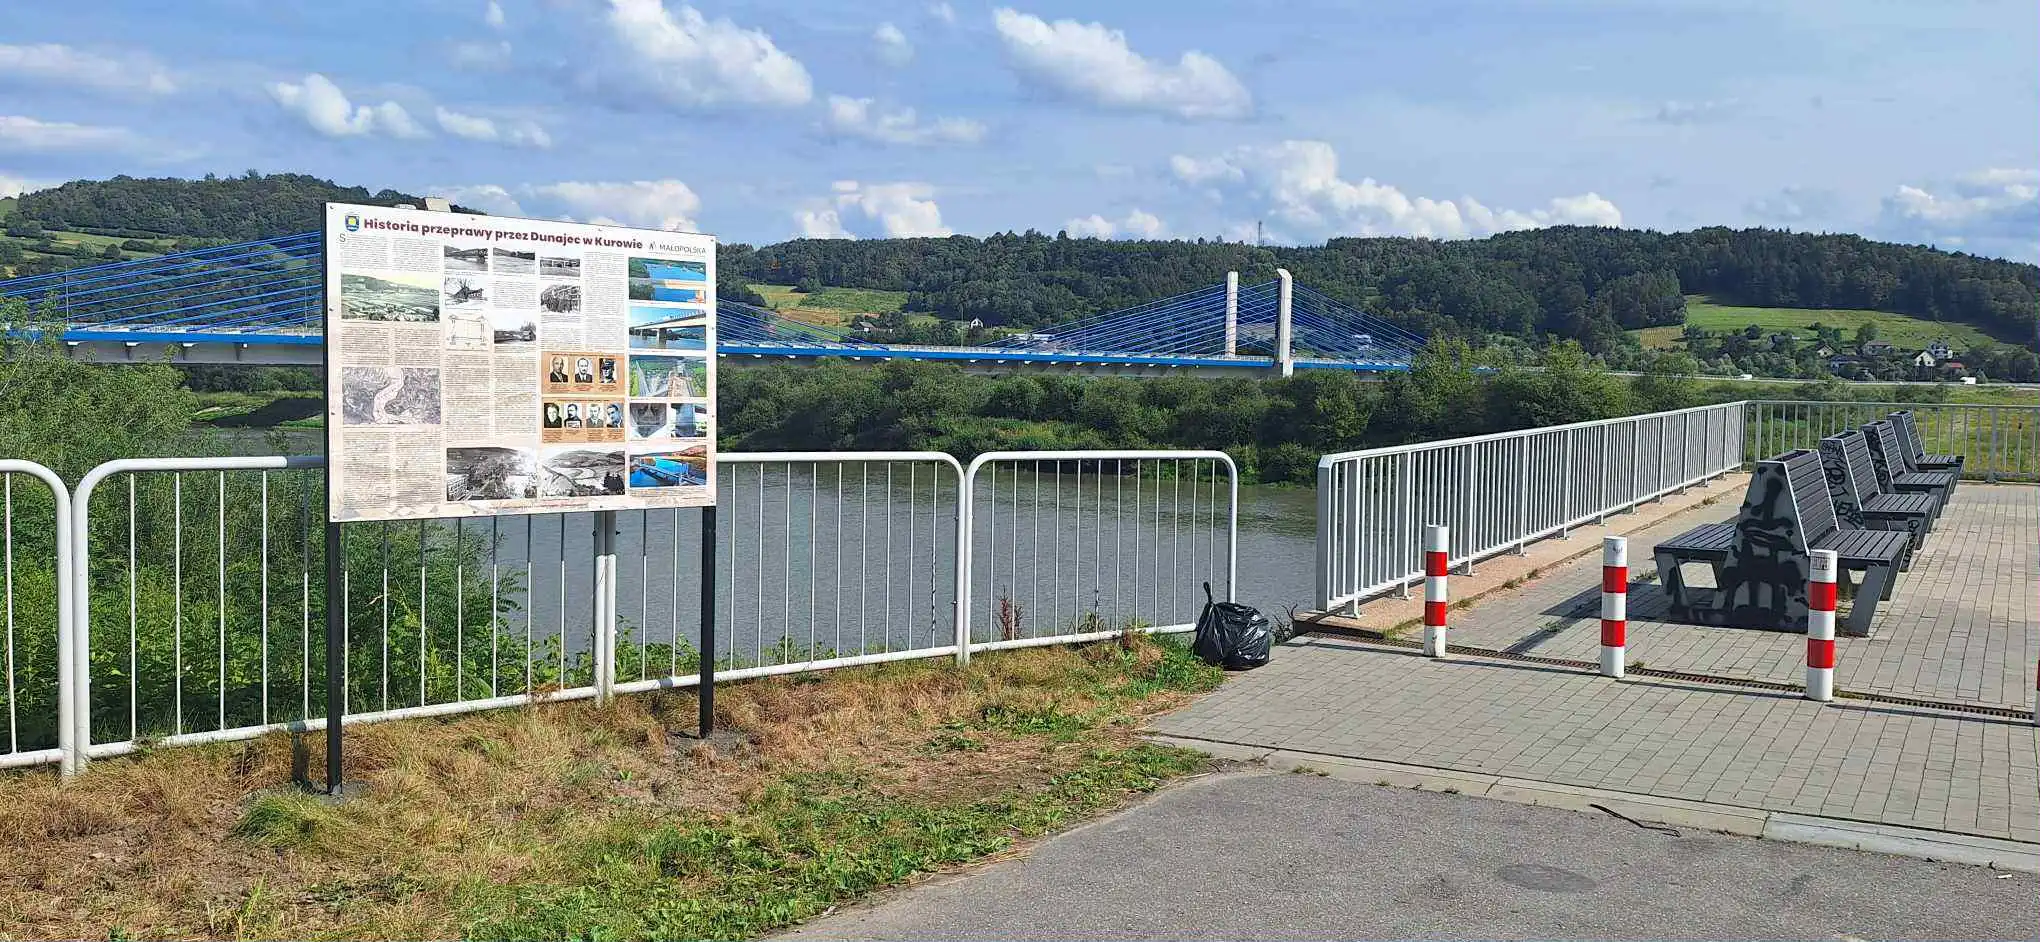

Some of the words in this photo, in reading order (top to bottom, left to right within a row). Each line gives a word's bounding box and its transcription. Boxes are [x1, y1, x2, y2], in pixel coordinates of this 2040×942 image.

[364, 218, 419, 232] Historia
[421, 223, 493, 241] przeprawy
[495, 229, 529, 242] przez
[530, 232, 581, 246] Dunajec
[583, 238, 593, 246] w
[595, 237, 643, 249] Kurowie
[659, 243, 706, 254] MAŁOPOLSKA
